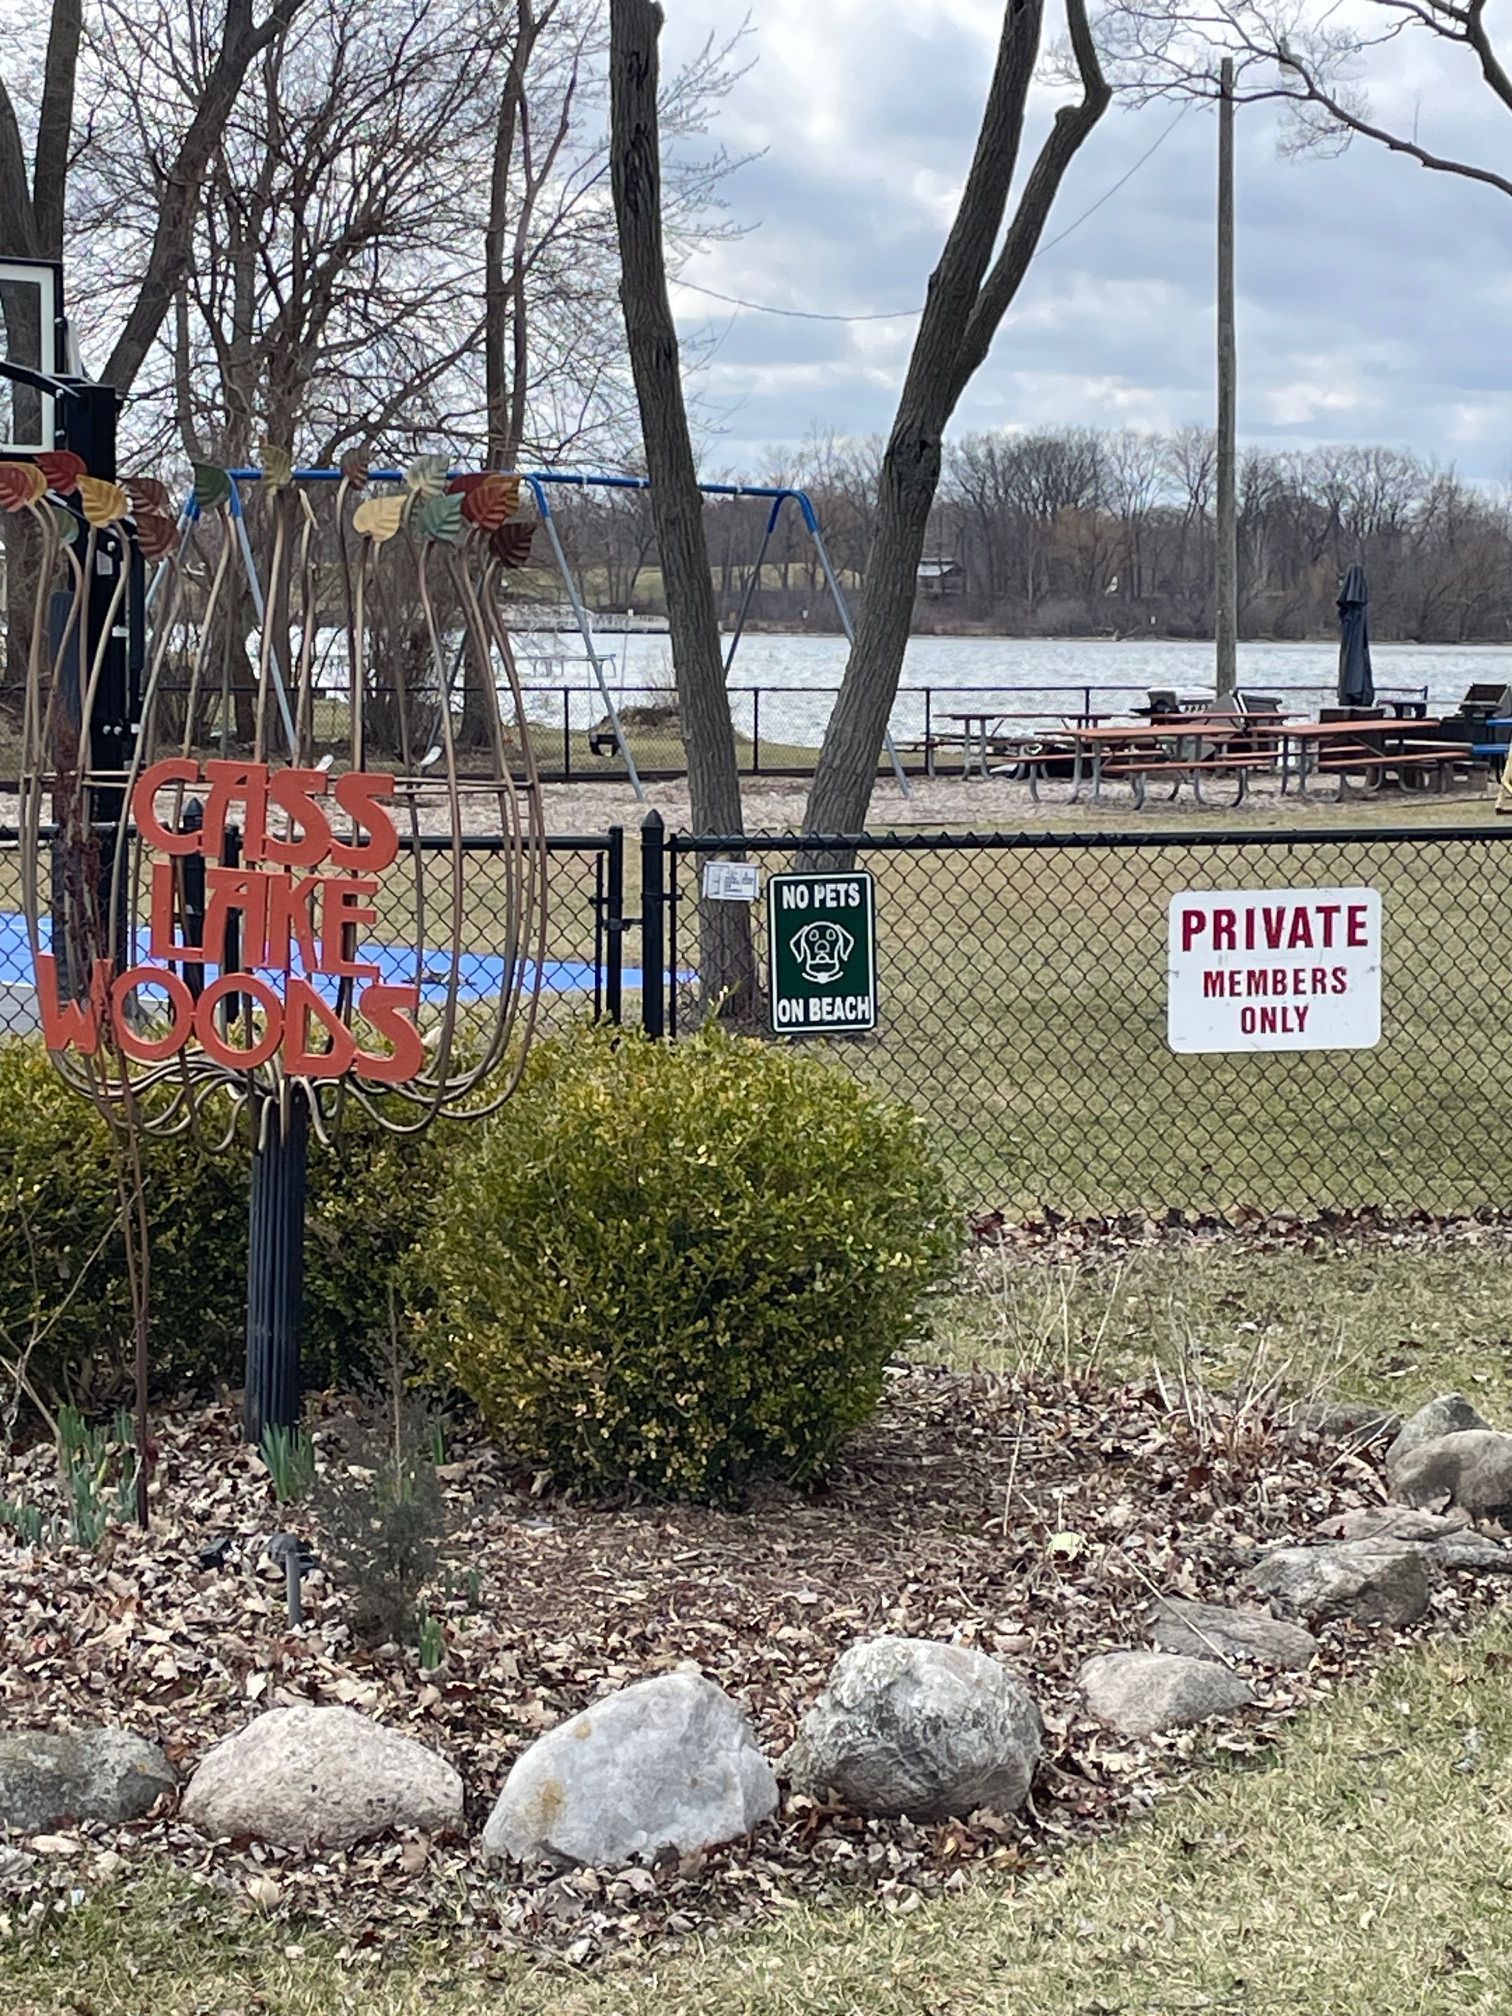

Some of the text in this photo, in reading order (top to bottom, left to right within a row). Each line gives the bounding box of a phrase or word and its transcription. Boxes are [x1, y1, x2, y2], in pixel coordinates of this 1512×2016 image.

[132, 757, 399, 872] CASS
[782, 882, 861, 909] NO PETS
[149, 863, 380, 980] LAKE
[1182, 905, 1368, 952] PRIVATE
[1203, 966, 1348, 998] MEMBERS
[37, 953, 425, 1082] WOODS
[778, 996, 870, 1023] ON BEACH
[1240, 1004, 1310, 1035] ONLY
